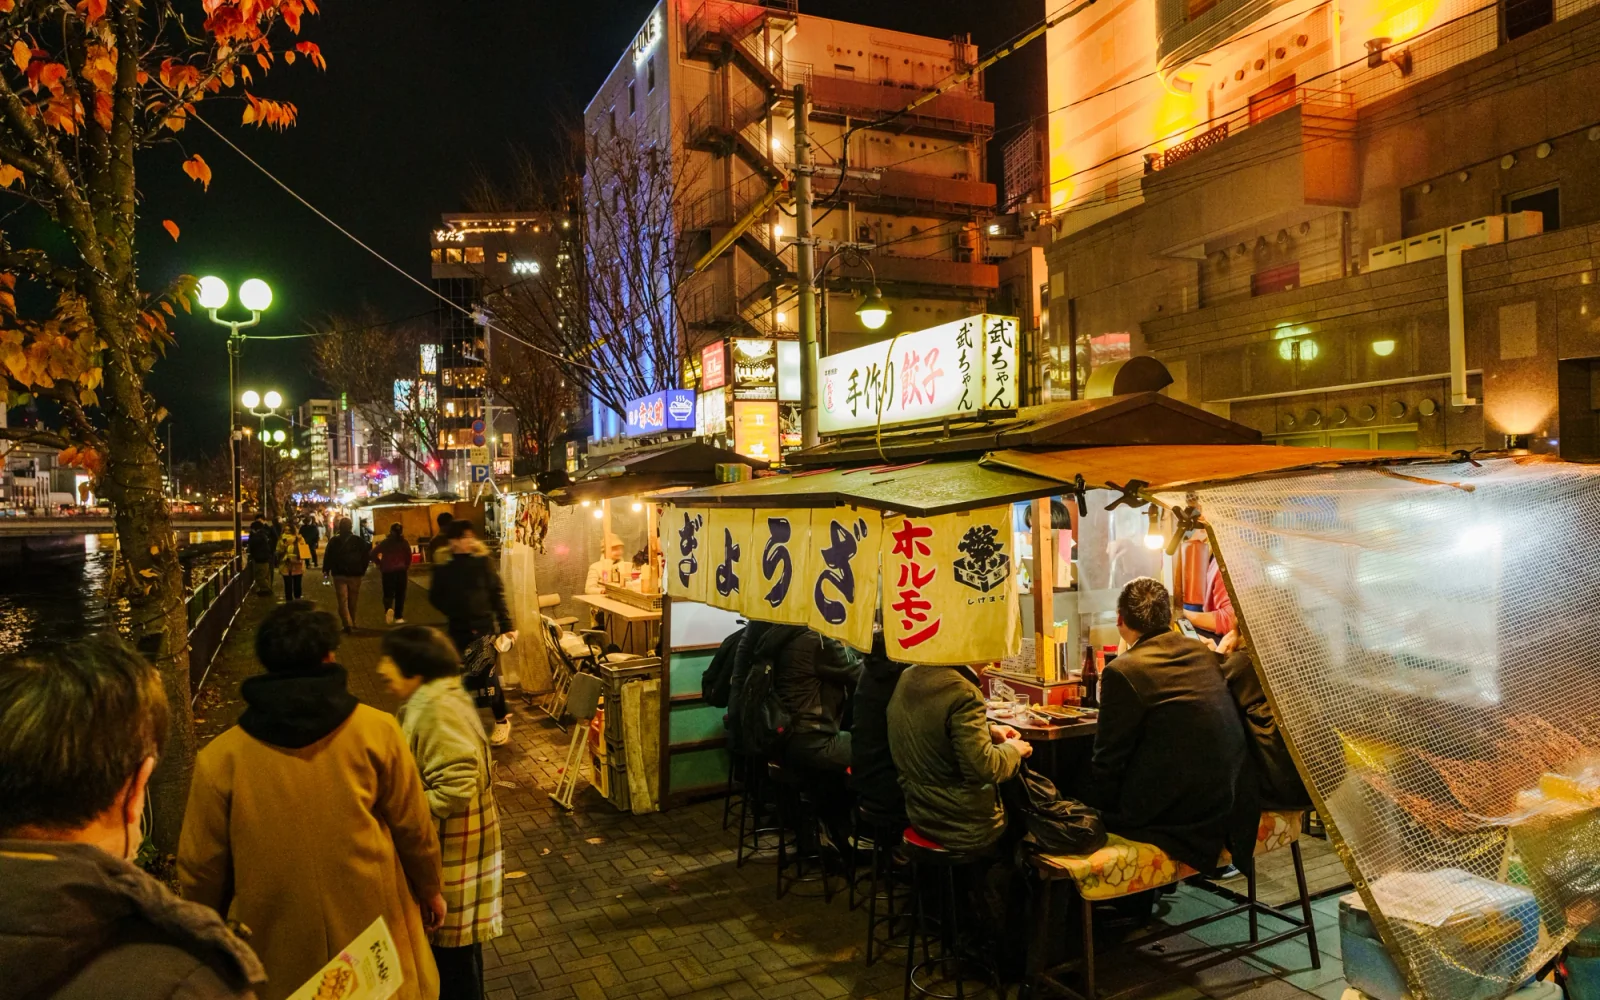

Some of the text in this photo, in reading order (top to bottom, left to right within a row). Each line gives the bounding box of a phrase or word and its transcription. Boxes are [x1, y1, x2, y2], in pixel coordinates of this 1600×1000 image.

[955, 322, 973, 411] 武ちゃん
[988, 318, 1013, 410] 武ちゃん
[475, 466, 487, 481] P
[891, 519, 941, 650] ホルモン
